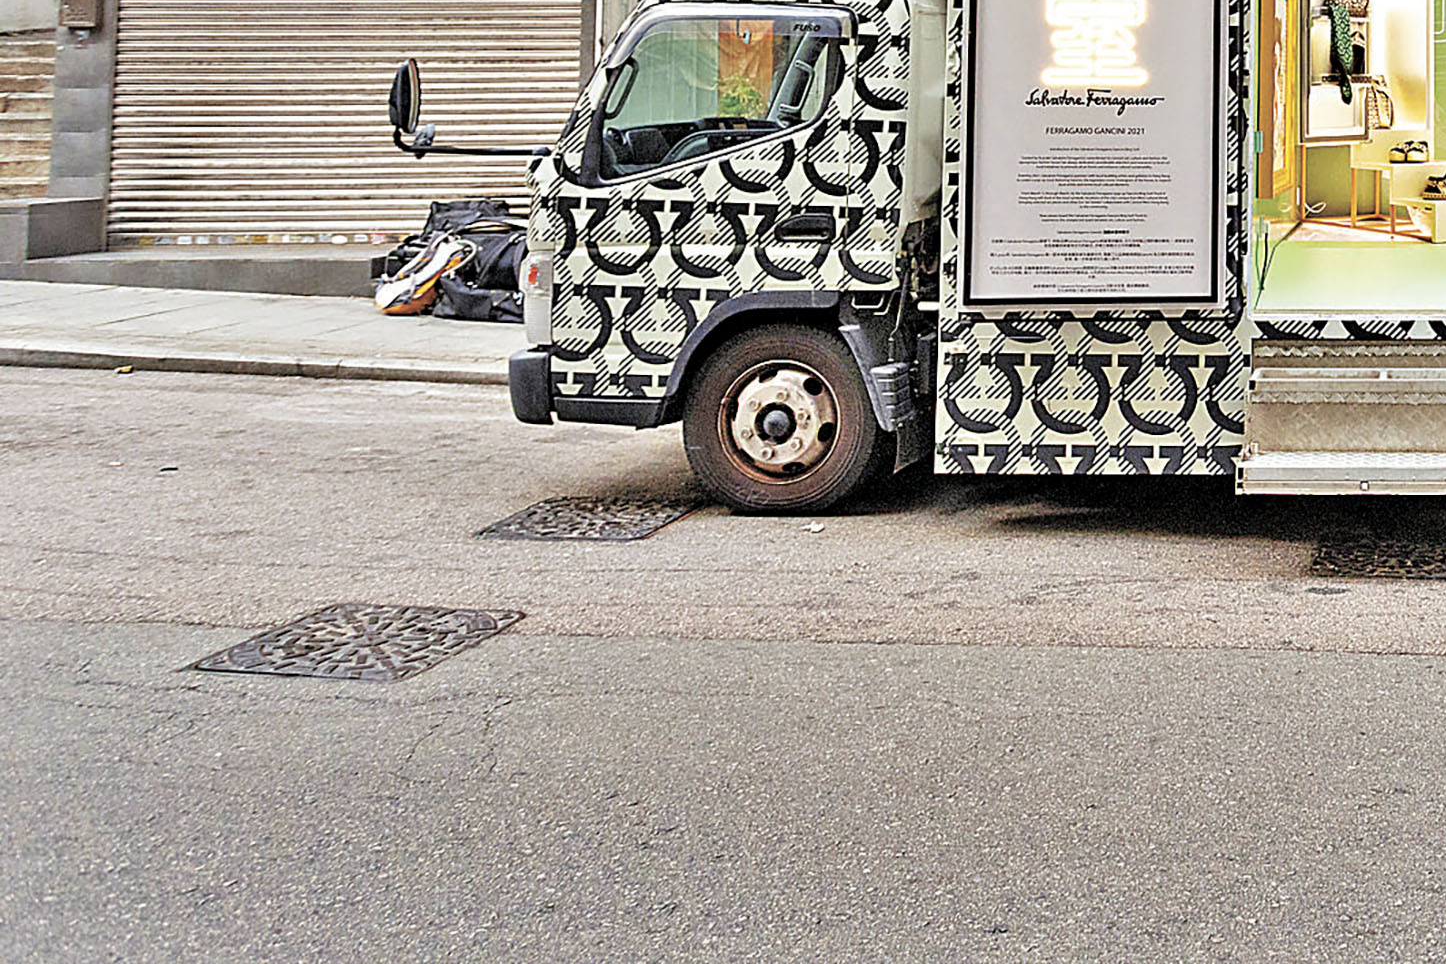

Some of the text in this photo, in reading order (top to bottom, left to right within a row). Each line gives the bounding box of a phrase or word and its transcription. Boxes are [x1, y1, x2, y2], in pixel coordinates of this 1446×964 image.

[793, 23, 821, 32] FUSO
[1025, 88, 1165, 116] Salvatore Ferragamo
[1046, 127, 1145, 135] FERRAGAMO GANCINI 2021
